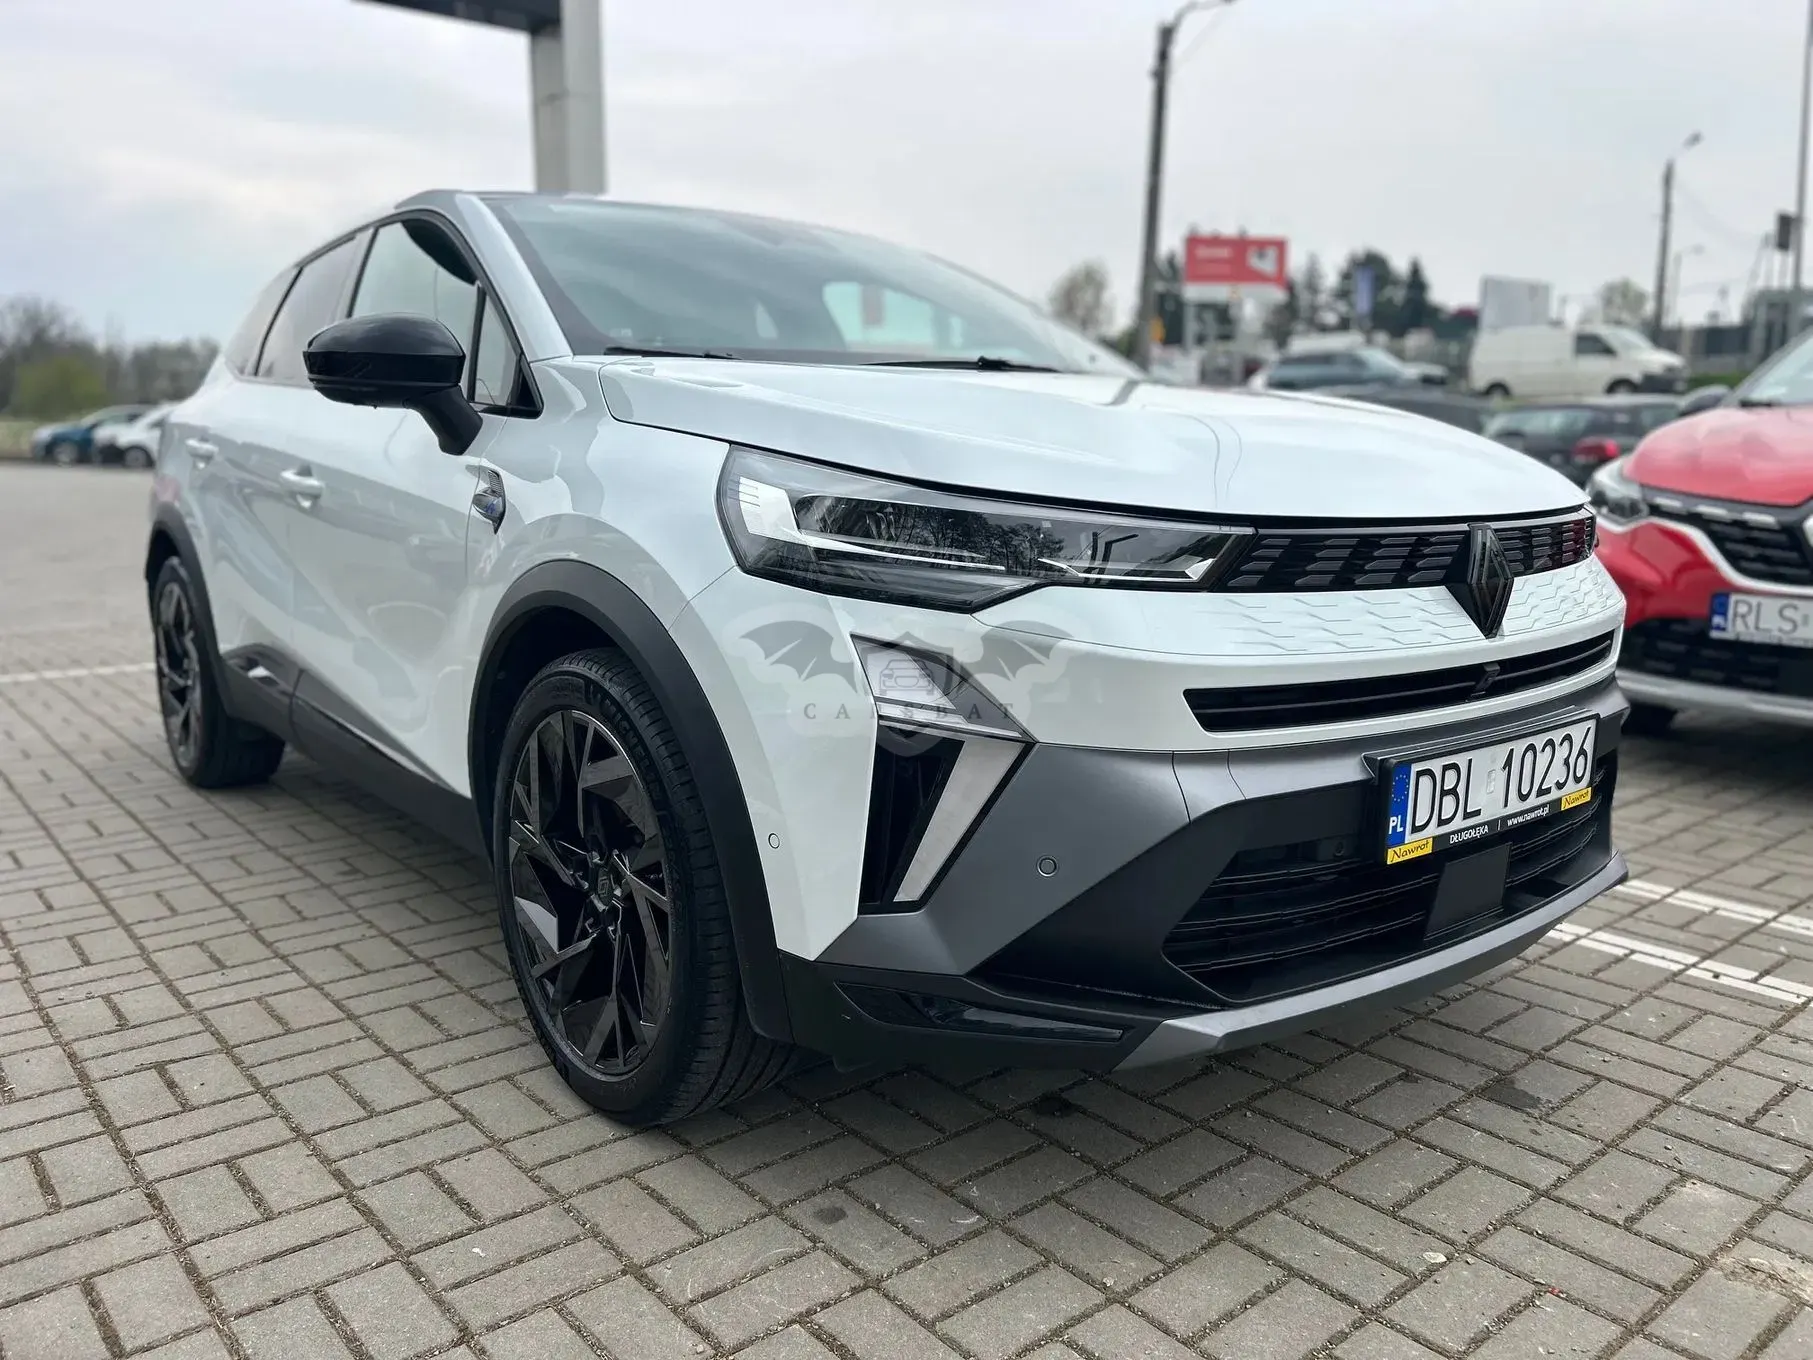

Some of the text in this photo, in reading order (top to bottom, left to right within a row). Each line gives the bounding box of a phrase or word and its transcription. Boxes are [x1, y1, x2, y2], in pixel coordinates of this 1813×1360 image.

[1732, 600, 1799, 634] RLS
[1411, 727, 1591, 834] DBL 10236
[1563, 791, 1590, 810] Nawrot
[1389, 817, 1404, 835] PL
[1450, 825, 1489, 844] DŁUGOŁĘKA
[1507, 804, 1550, 827] www.nawrot.pl
[1390, 841, 1429, 863] Nawrot
